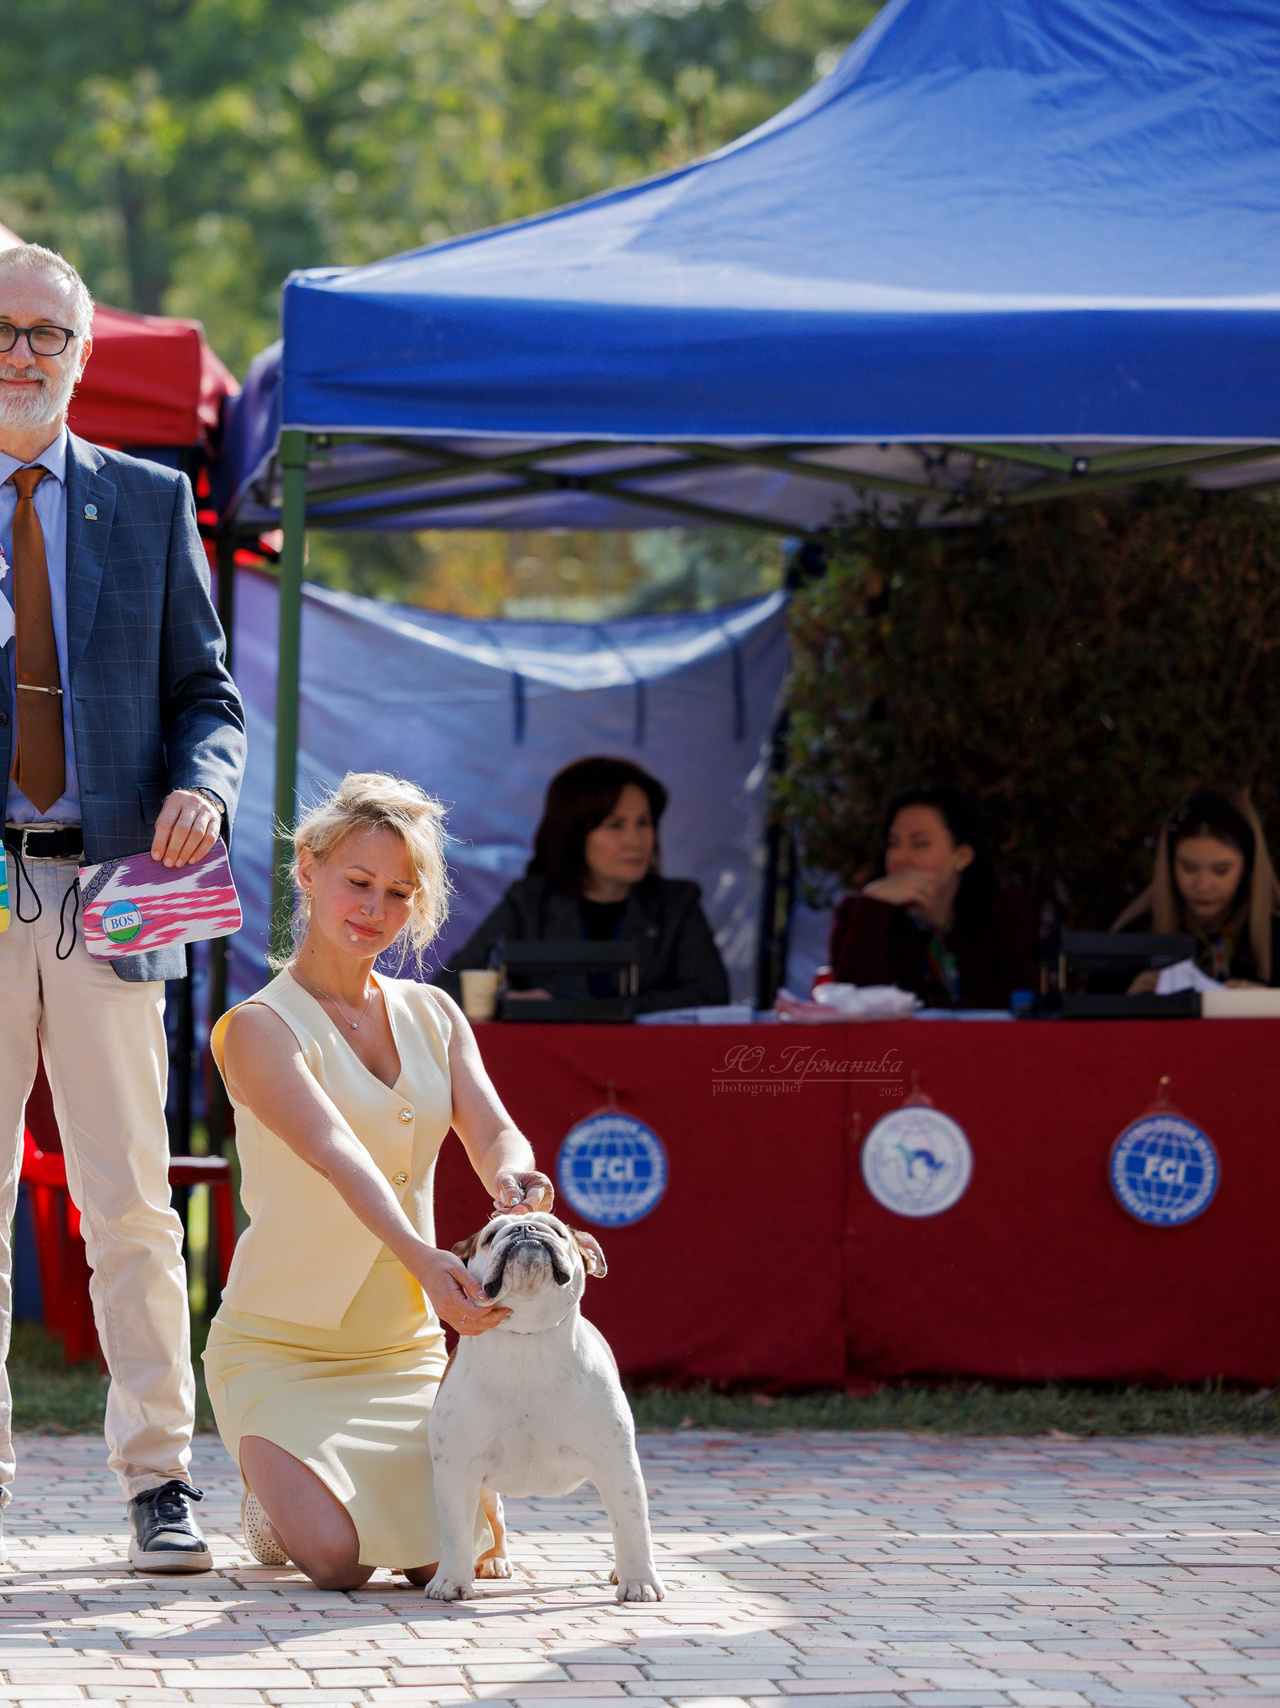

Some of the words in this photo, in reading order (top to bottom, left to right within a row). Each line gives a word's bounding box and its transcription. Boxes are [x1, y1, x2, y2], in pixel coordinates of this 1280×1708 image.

[110, 914, 134, 929] BOS
[591, 1156, 634, 1182] FCI
[1143, 1155, 1187, 1185] FCI
